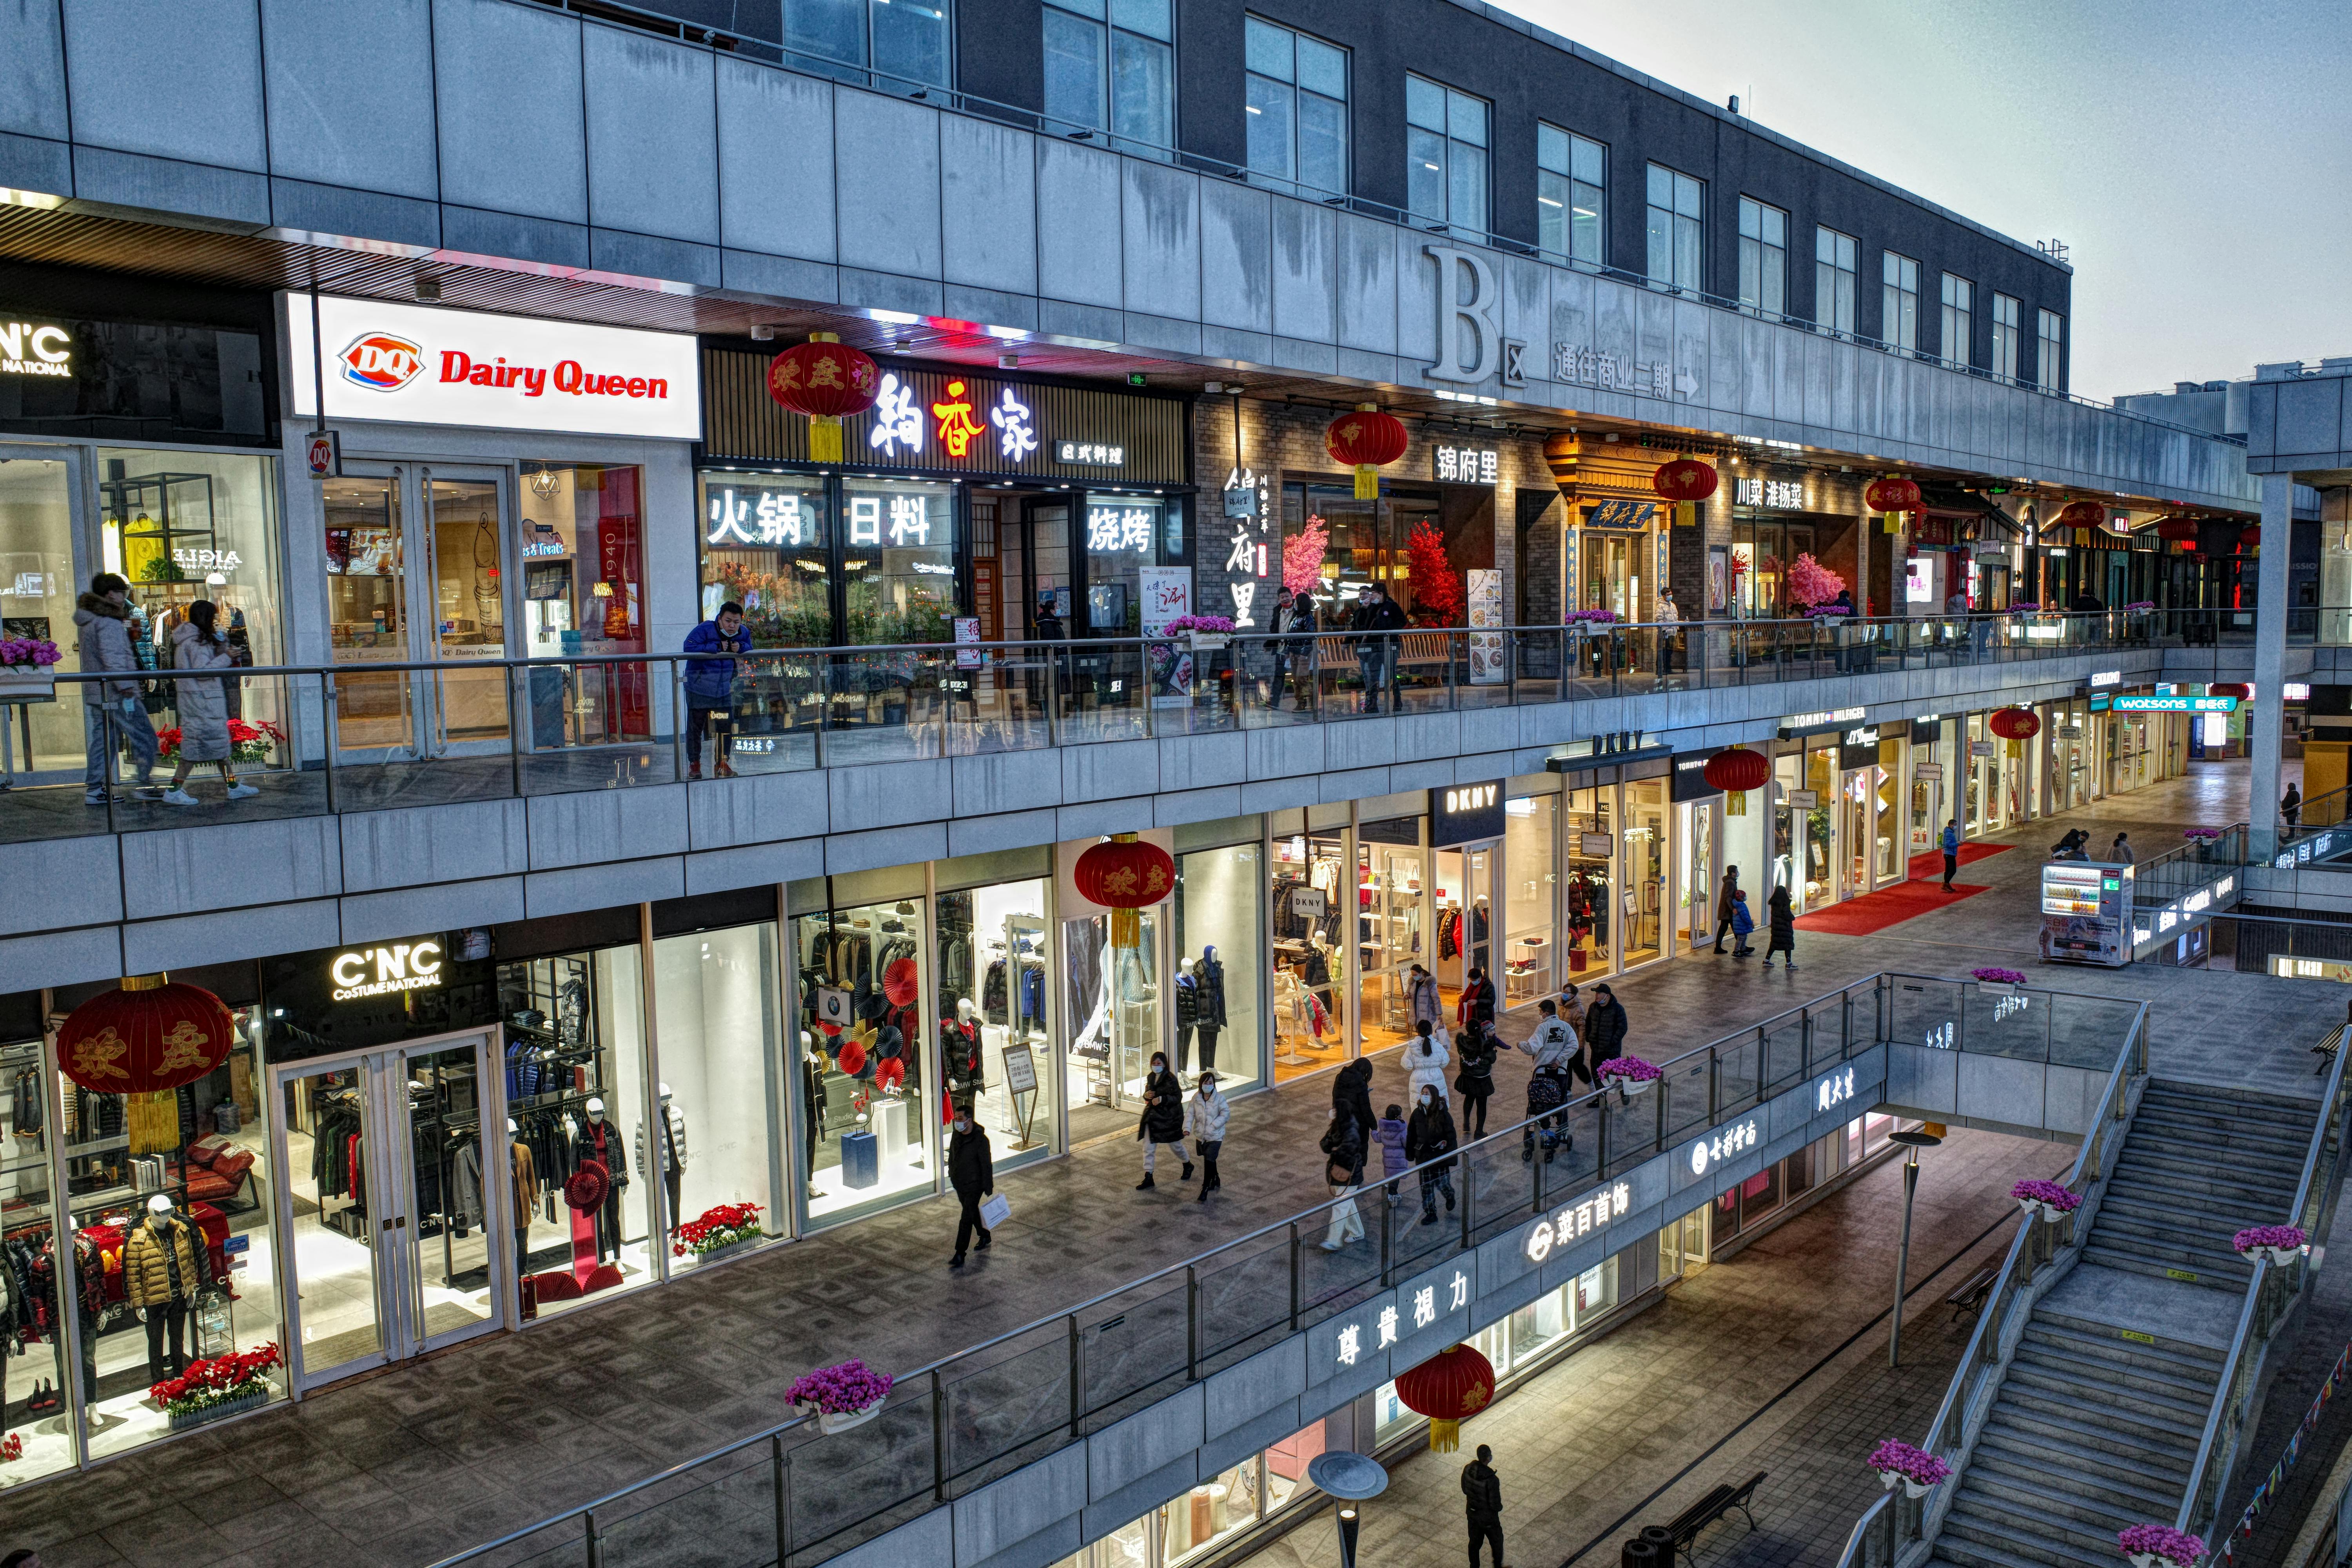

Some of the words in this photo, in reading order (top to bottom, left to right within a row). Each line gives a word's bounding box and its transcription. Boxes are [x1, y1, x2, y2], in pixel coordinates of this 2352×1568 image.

[2, 359, 71, 377] NATIONAL
[358, 345, 409, 377] DQ
[439, 350, 546, 397] Dairy
[553, 360, 668, 399] Queen
[313, 446, 329, 466] DQ
[1062, 444, 1122, 465] 日式料理
[1437, 445, 1499, 484] 锦府里
[1737, 478, 1762, 506] 川菜
[1766, 480, 1802, 509] 淮扬菜
[707, 490, 801, 545] 火锅
[851, 495, 930, 545] 日料
[1087, 508, 1151, 553] 烧烤
[539, 542, 564, 555] Treats
[606, 533, 617, 579] 1940
[2121, 699, 2187, 709] watsons
[2196, 699, 2228, 709] 屈臣氏
[1794, 712, 1825, 728] TOMMY
[1834, 707, 1865, 722] HILFIGER
[1592, 730, 1644, 756] DKNY
[1678, 760, 1698, 771] TOMMY
[1447, 785, 1496, 813] DKNY
[1296, 898, 1321, 908] DKNY
[333, 942, 441, 987] C'N'C
[386, 974, 441, 993] NATIONAL
[1187, 1020, 1199, 1029] BMW
[1084, 1040, 1102, 1052] BMW
[956, 1080, 971, 1091] BMW
[972, 1076, 990, 1087] Studio
[1818, 1067, 1854, 1112] 周大生
[833, 1113, 853, 1123] Studio
[1557, 1182, 1630, 1246] 菜百首饰
